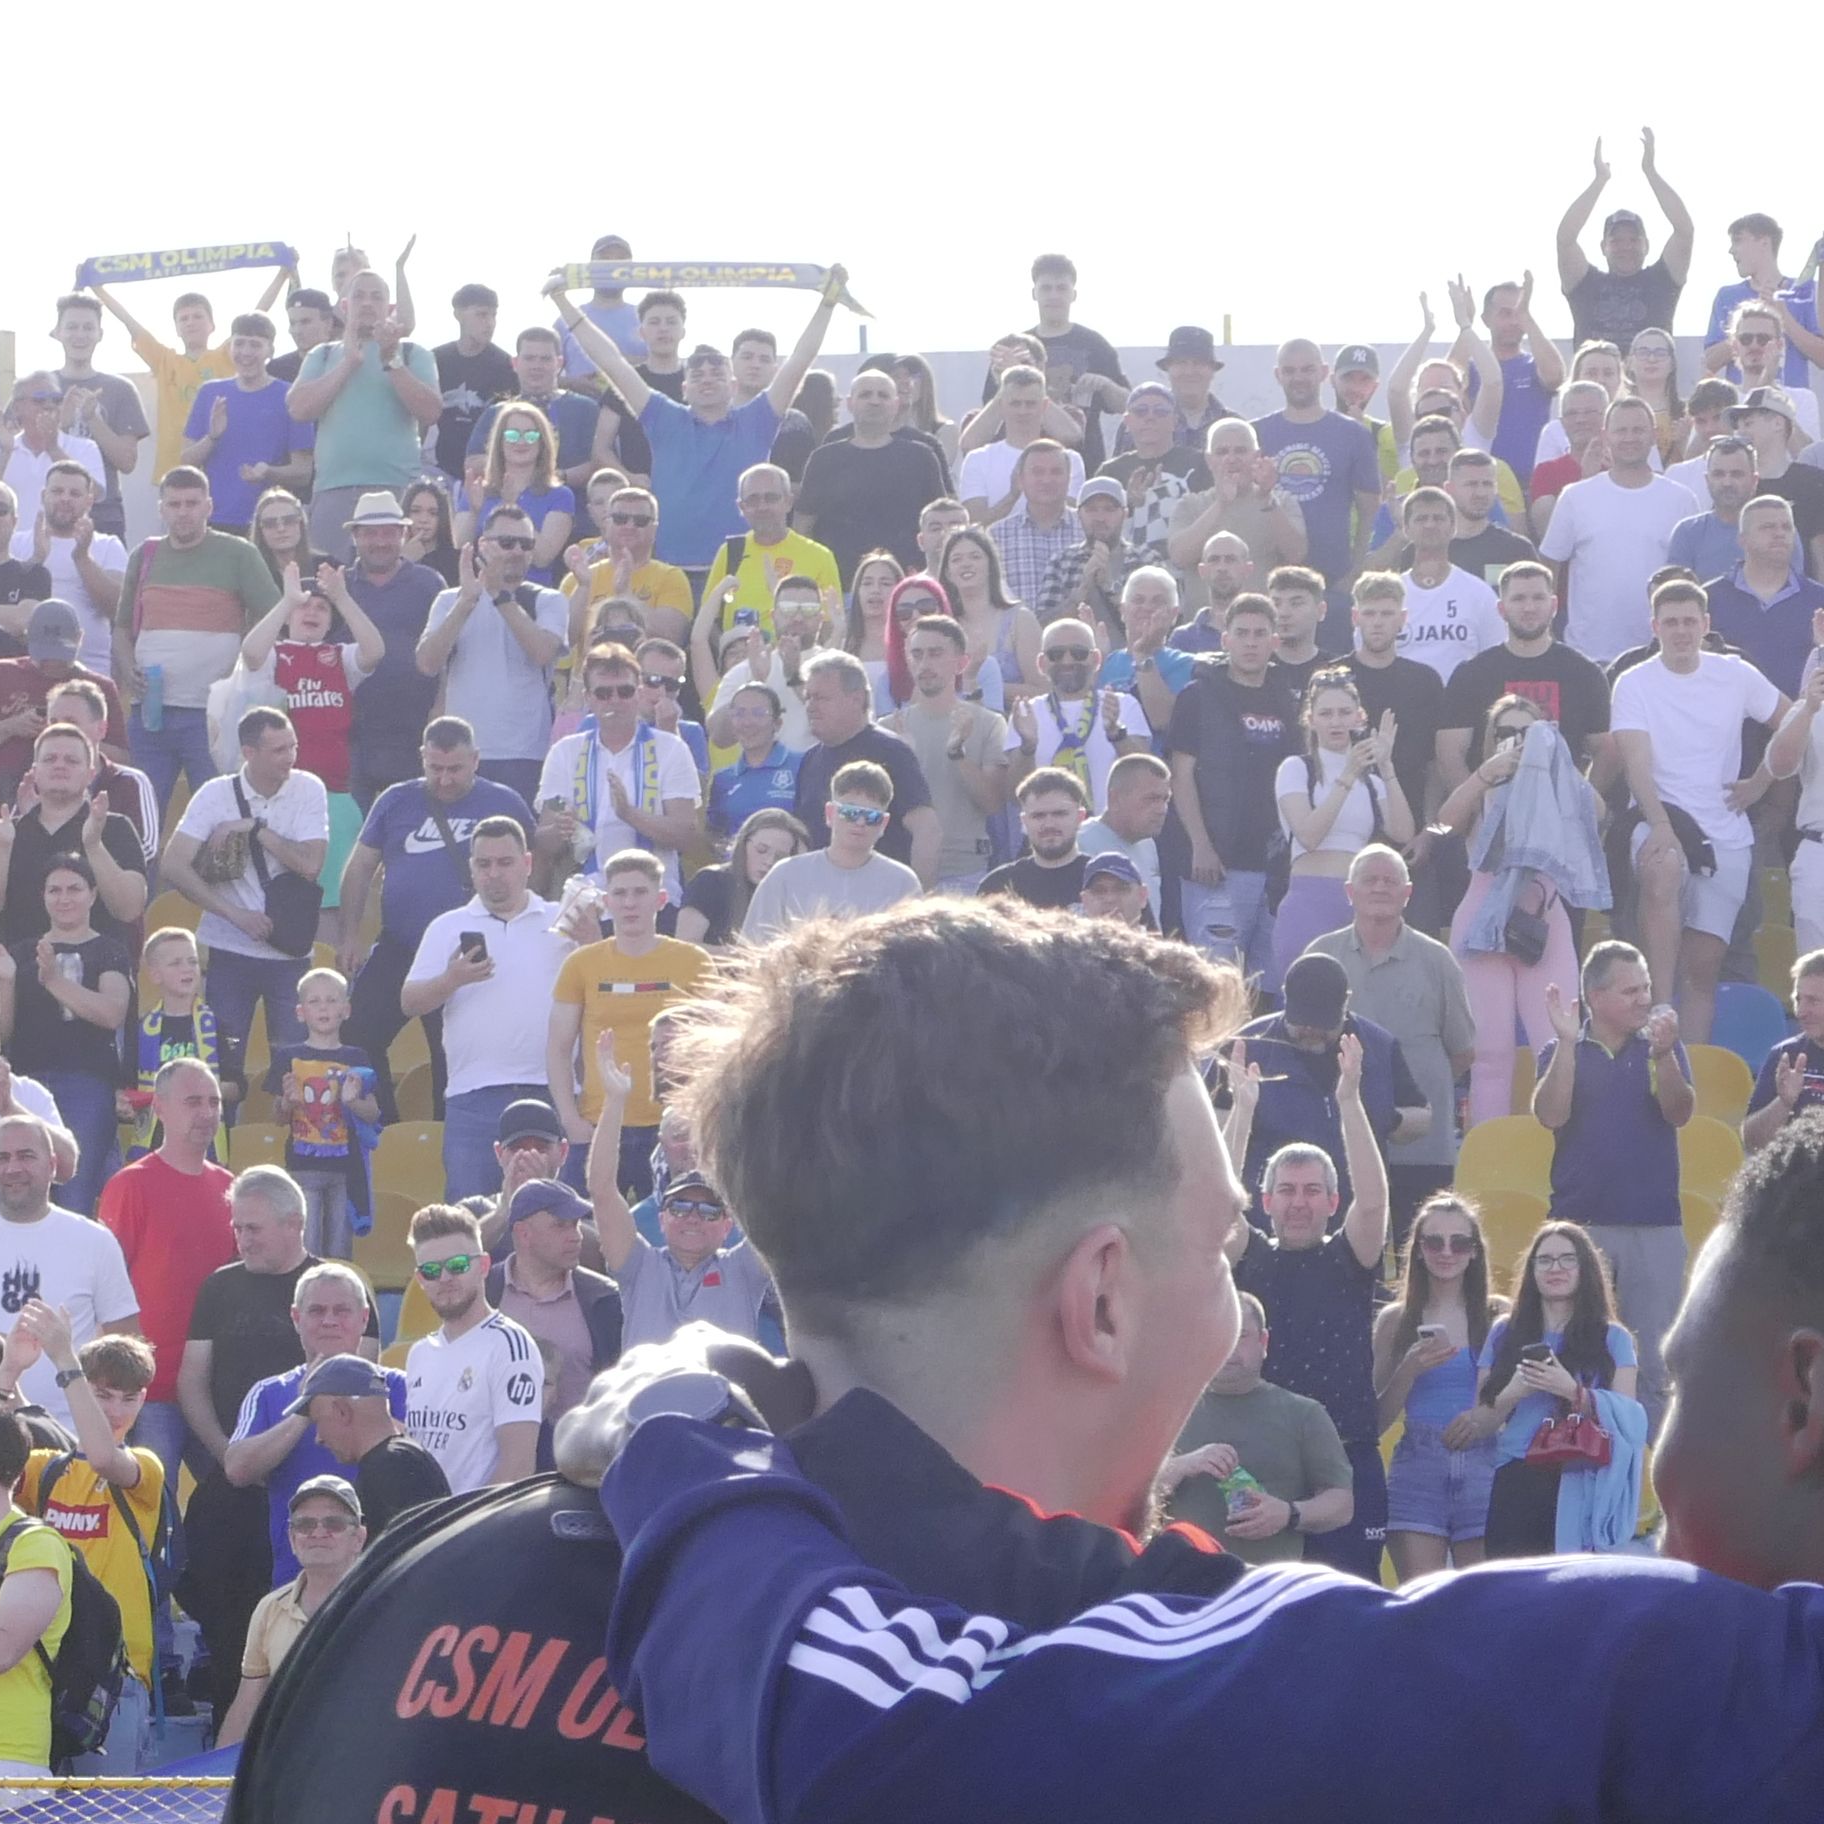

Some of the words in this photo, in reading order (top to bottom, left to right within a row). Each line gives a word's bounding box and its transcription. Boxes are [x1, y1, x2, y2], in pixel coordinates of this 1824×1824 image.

[93, 253, 152, 275] CSM
[160, 242, 276, 267] OLIMPIA
[1446, 599, 1458, 619] 5
[1414, 624, 1468, 642] JAKO
[510, 1373, 536, 1406] hp
[396, 1623, 573, 1735] CSM
